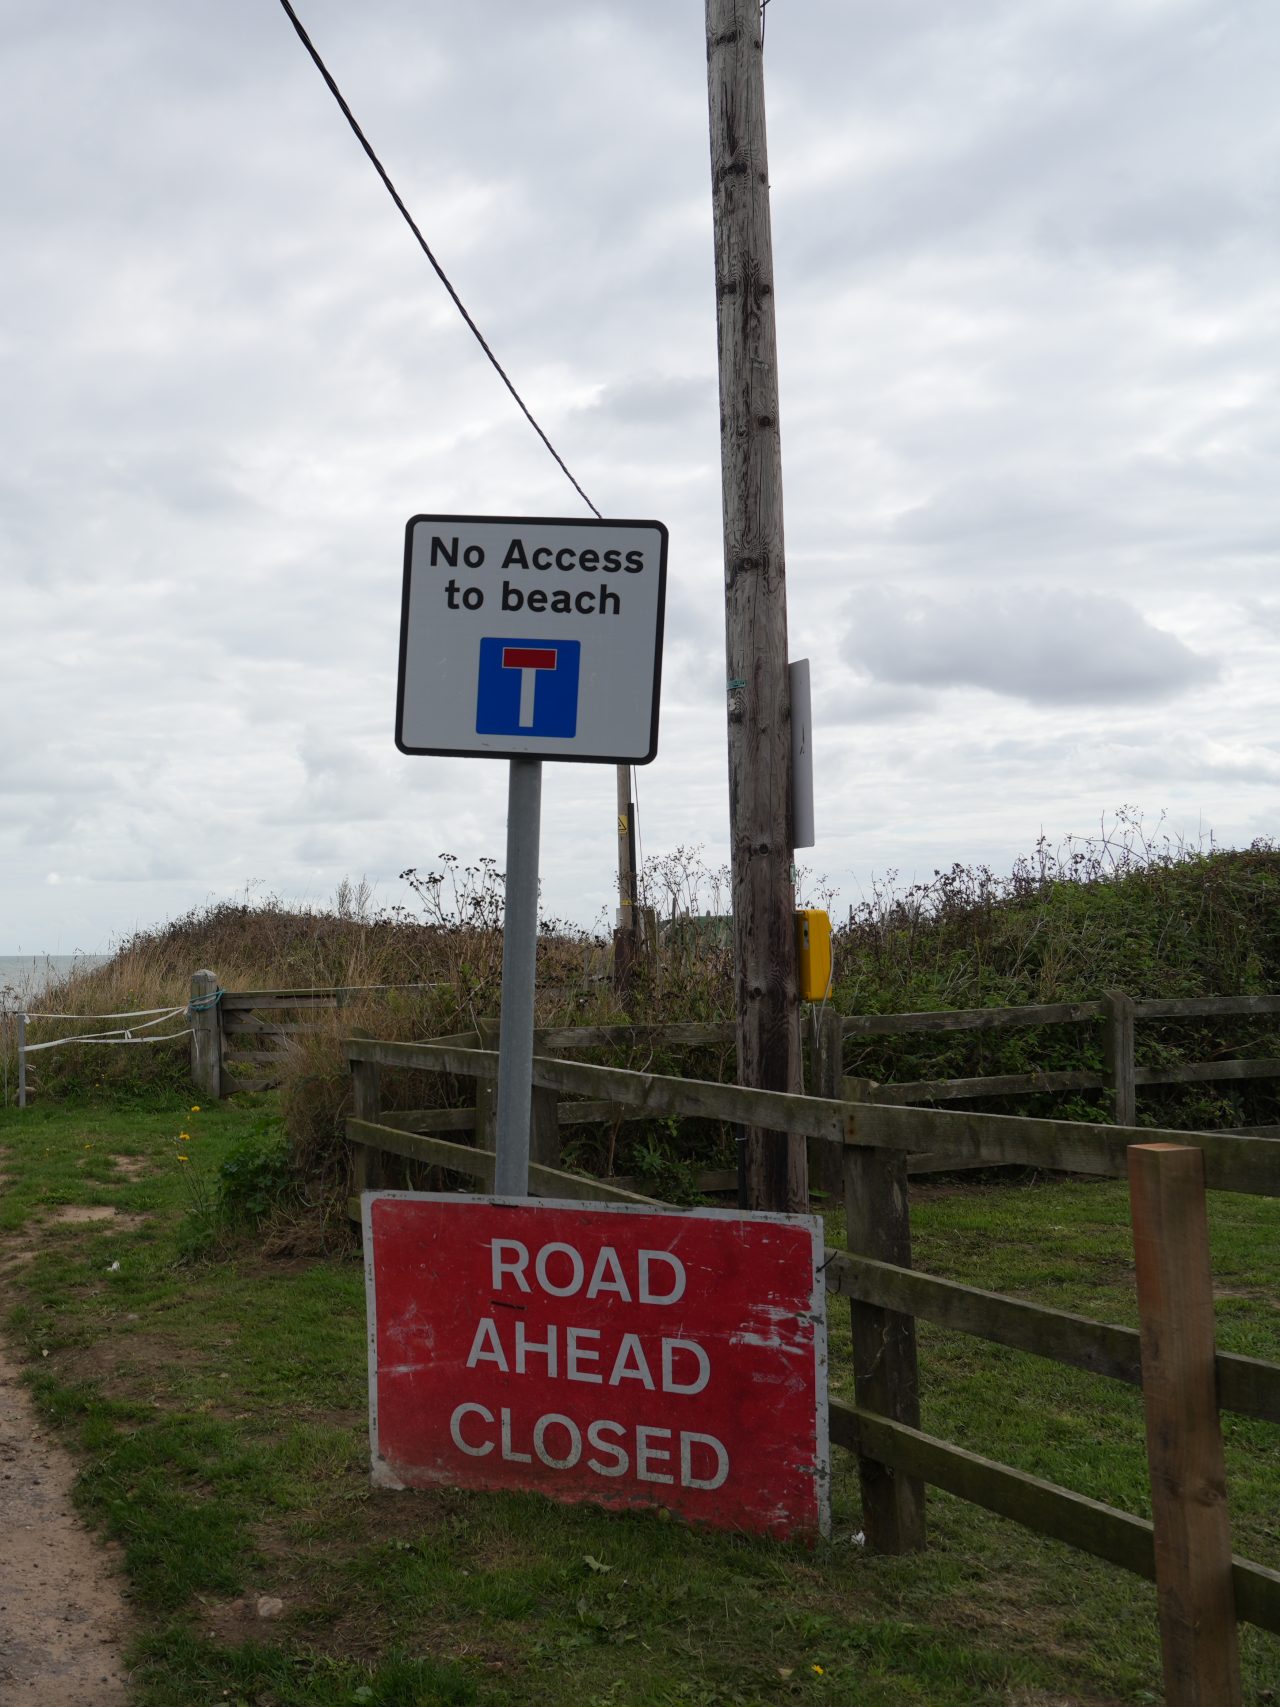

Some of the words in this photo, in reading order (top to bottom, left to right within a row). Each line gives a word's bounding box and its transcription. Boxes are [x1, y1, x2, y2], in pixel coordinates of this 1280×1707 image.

[429, 536, 485, 568] No
[501, 538, 644, 573] Access
[445, 579, 484, 611] to
[501, 581, 620, 615] beach
[490, 1237, 687, 1306] ROAD
[465, 1317, 711, 1395] AHEAD
[449, 1402, 730, 1491] CLOSED
